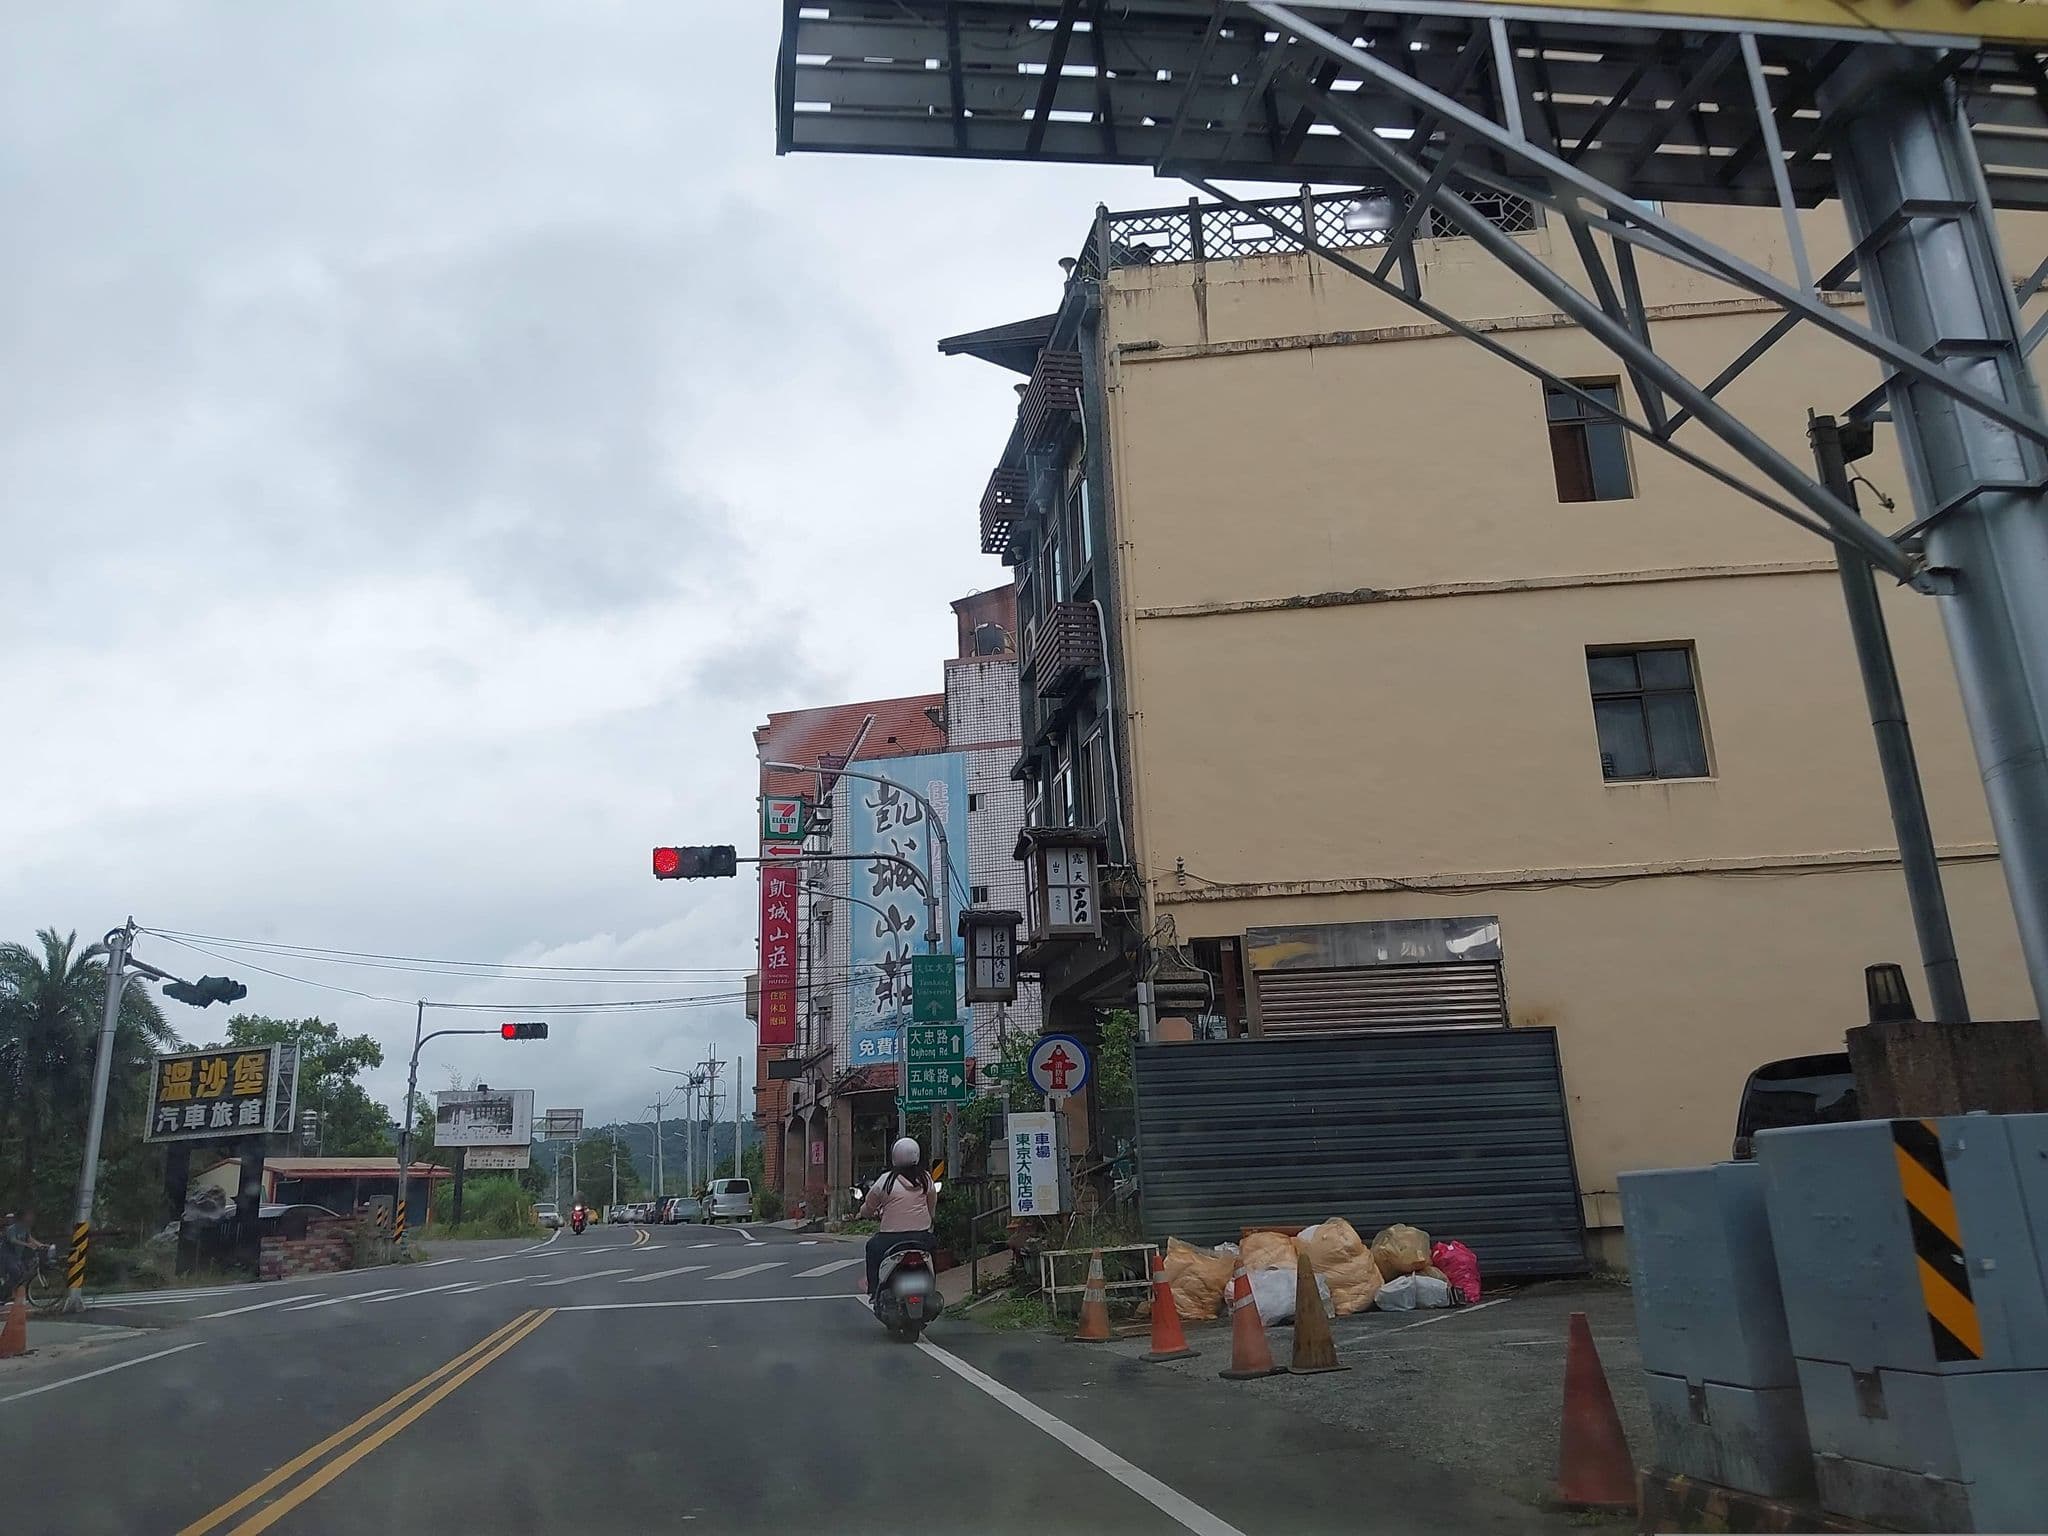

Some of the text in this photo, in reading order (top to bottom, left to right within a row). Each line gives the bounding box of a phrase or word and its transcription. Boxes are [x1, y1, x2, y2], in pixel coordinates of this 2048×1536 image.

[768, 879, 791, 969] 凱城山莊
[910, 1029, 948, 1045] 大忠路
[910, 1068, 949, 1083] 五峰路
[1055, 1061, 1064, 1085] 消防栓
[938, 1087, 948, 1096] Rd
[156, 1098, 263, 1132] 汽車旅館
[1034, 1133, 1050, 1158] 車場
[1015, 1133, 1034, 1212] 東京大飯店停
